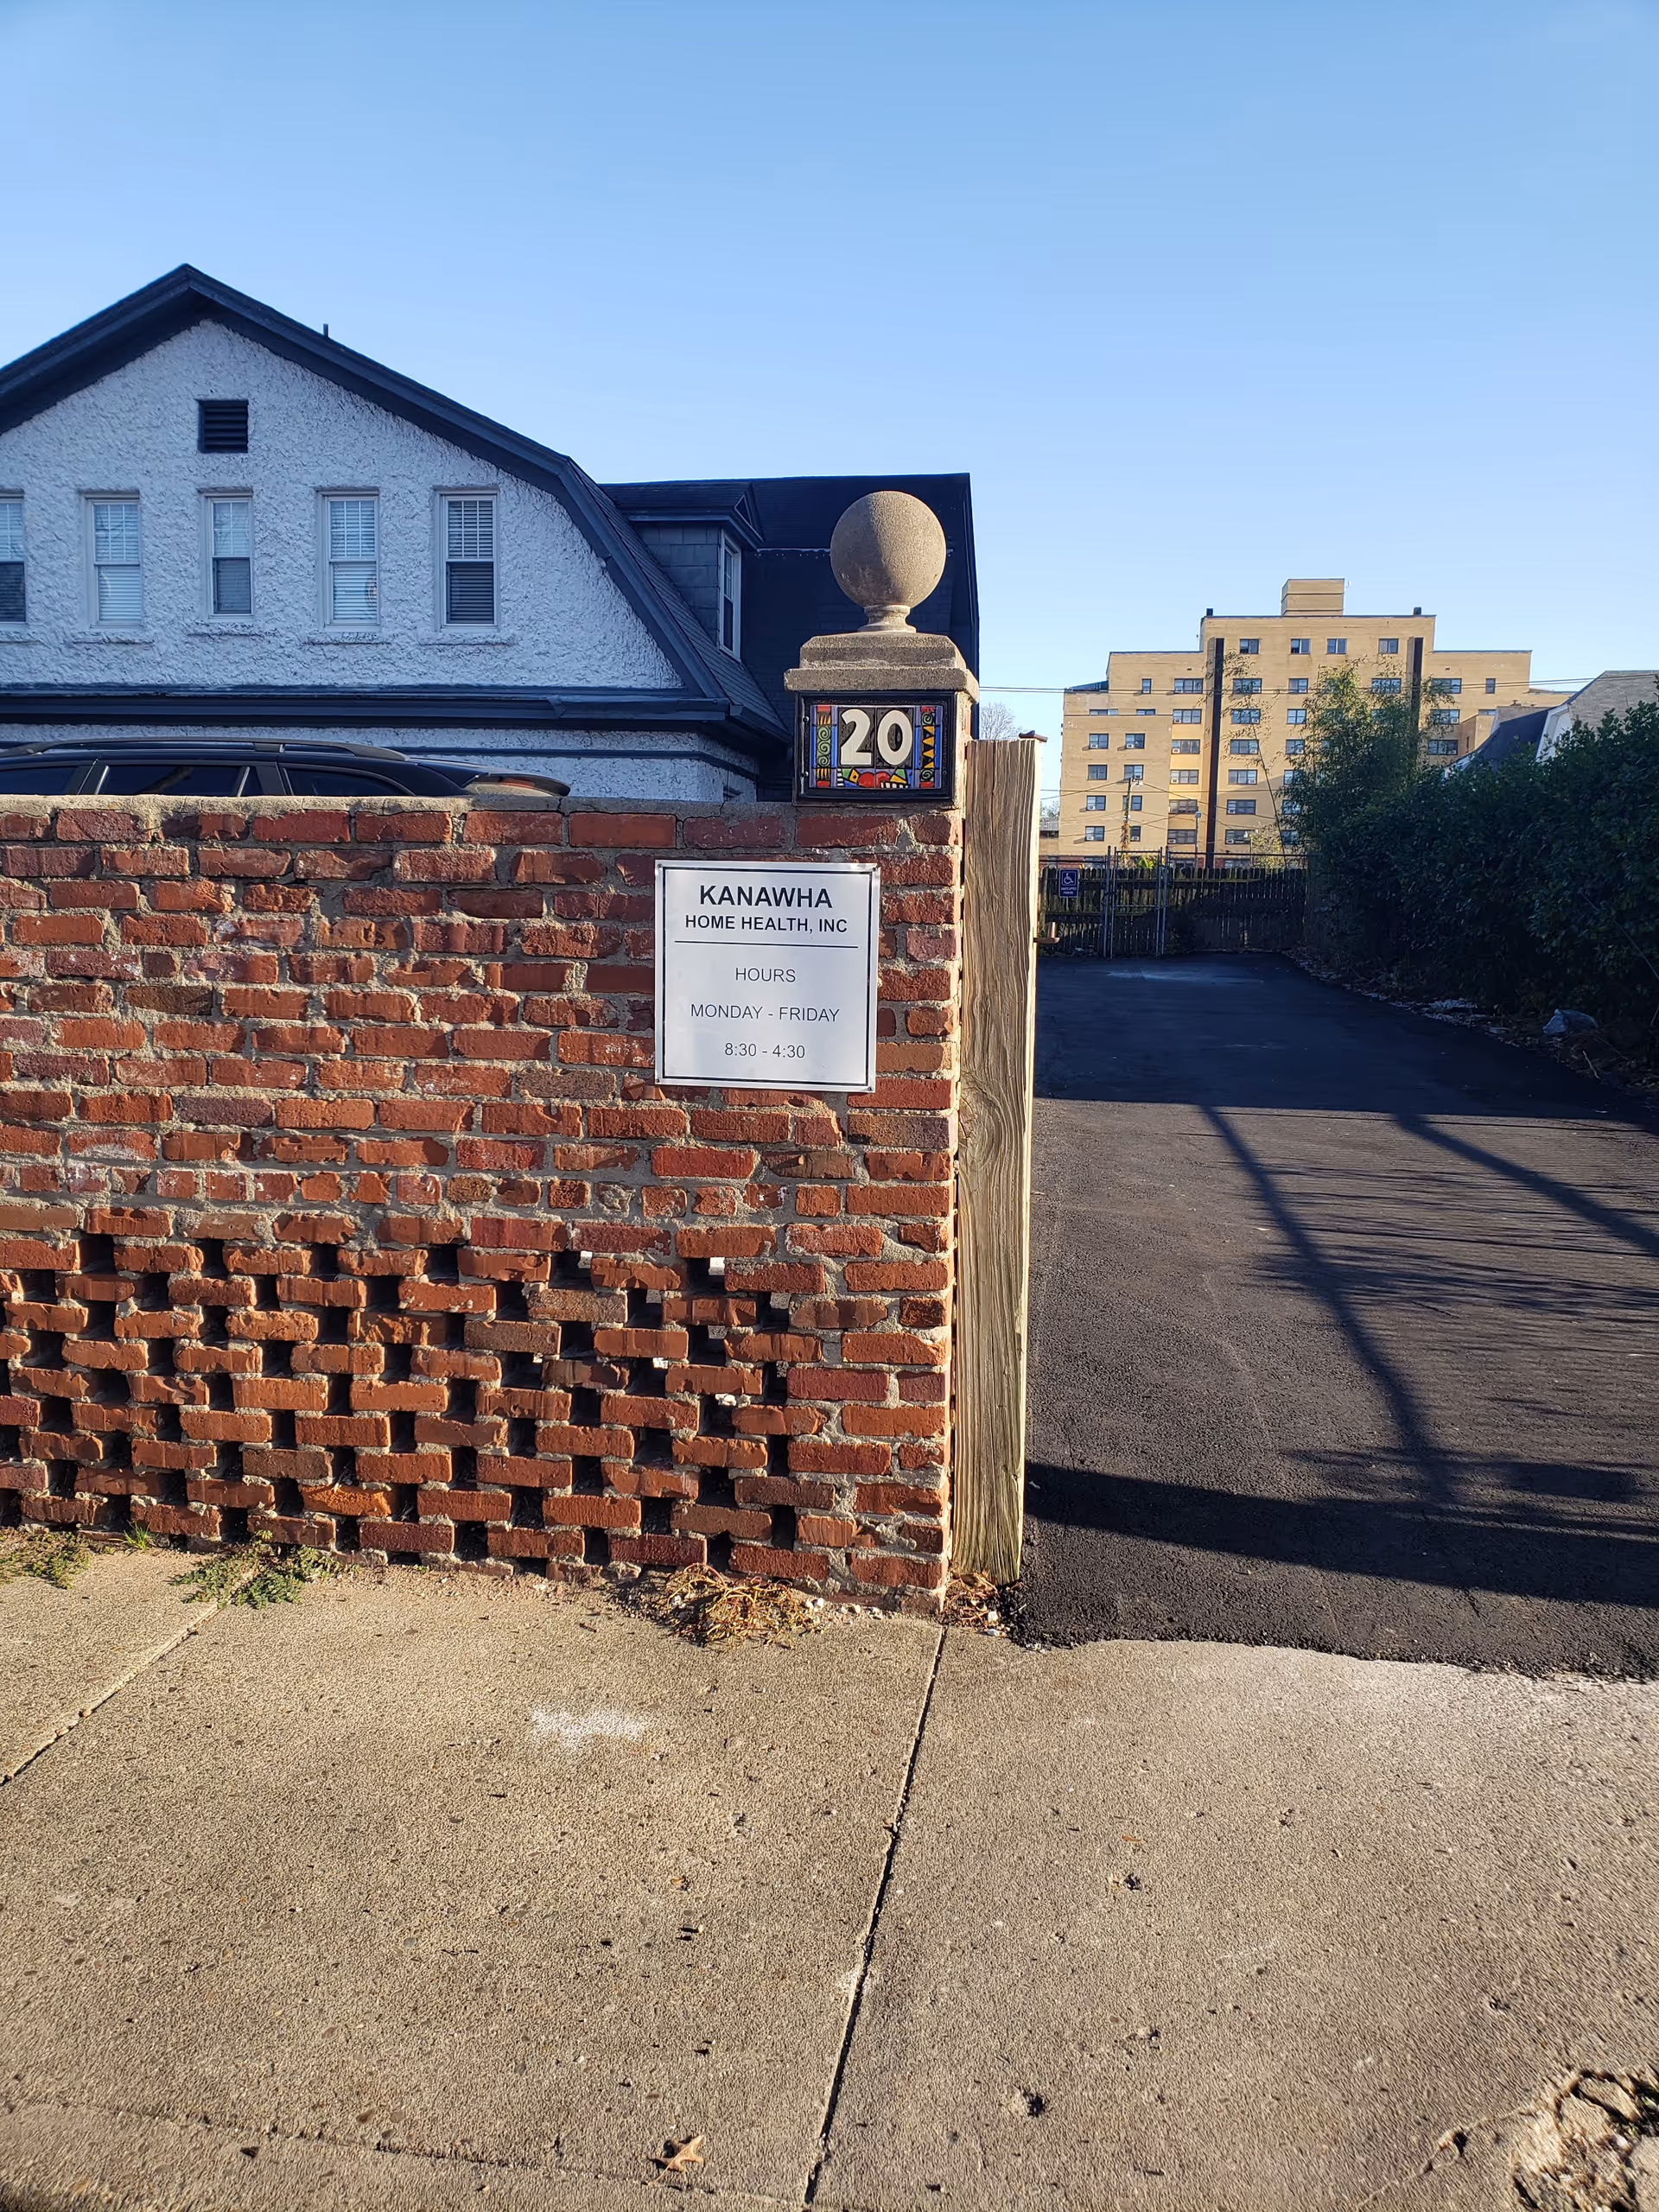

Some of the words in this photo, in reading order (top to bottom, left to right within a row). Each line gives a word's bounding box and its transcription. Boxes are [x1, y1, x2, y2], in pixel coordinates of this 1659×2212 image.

[840, 709, 913, 766] 20
[700, 885, 833, 908] KANAWHA
[685, 914, 735, 930] HOME
[741, 916, 814, 934] HEALTH,
[819, 918, 848, 933] INC
[734, 967, 796, 983] HOURS
[690, 1003, 764, 1020] MONDAY
[779, 1007, 841, 1022] FRIDAY
[724, 1042, 757, 1058] 8:30
[772, 1044, 805, 1058] 4:30
